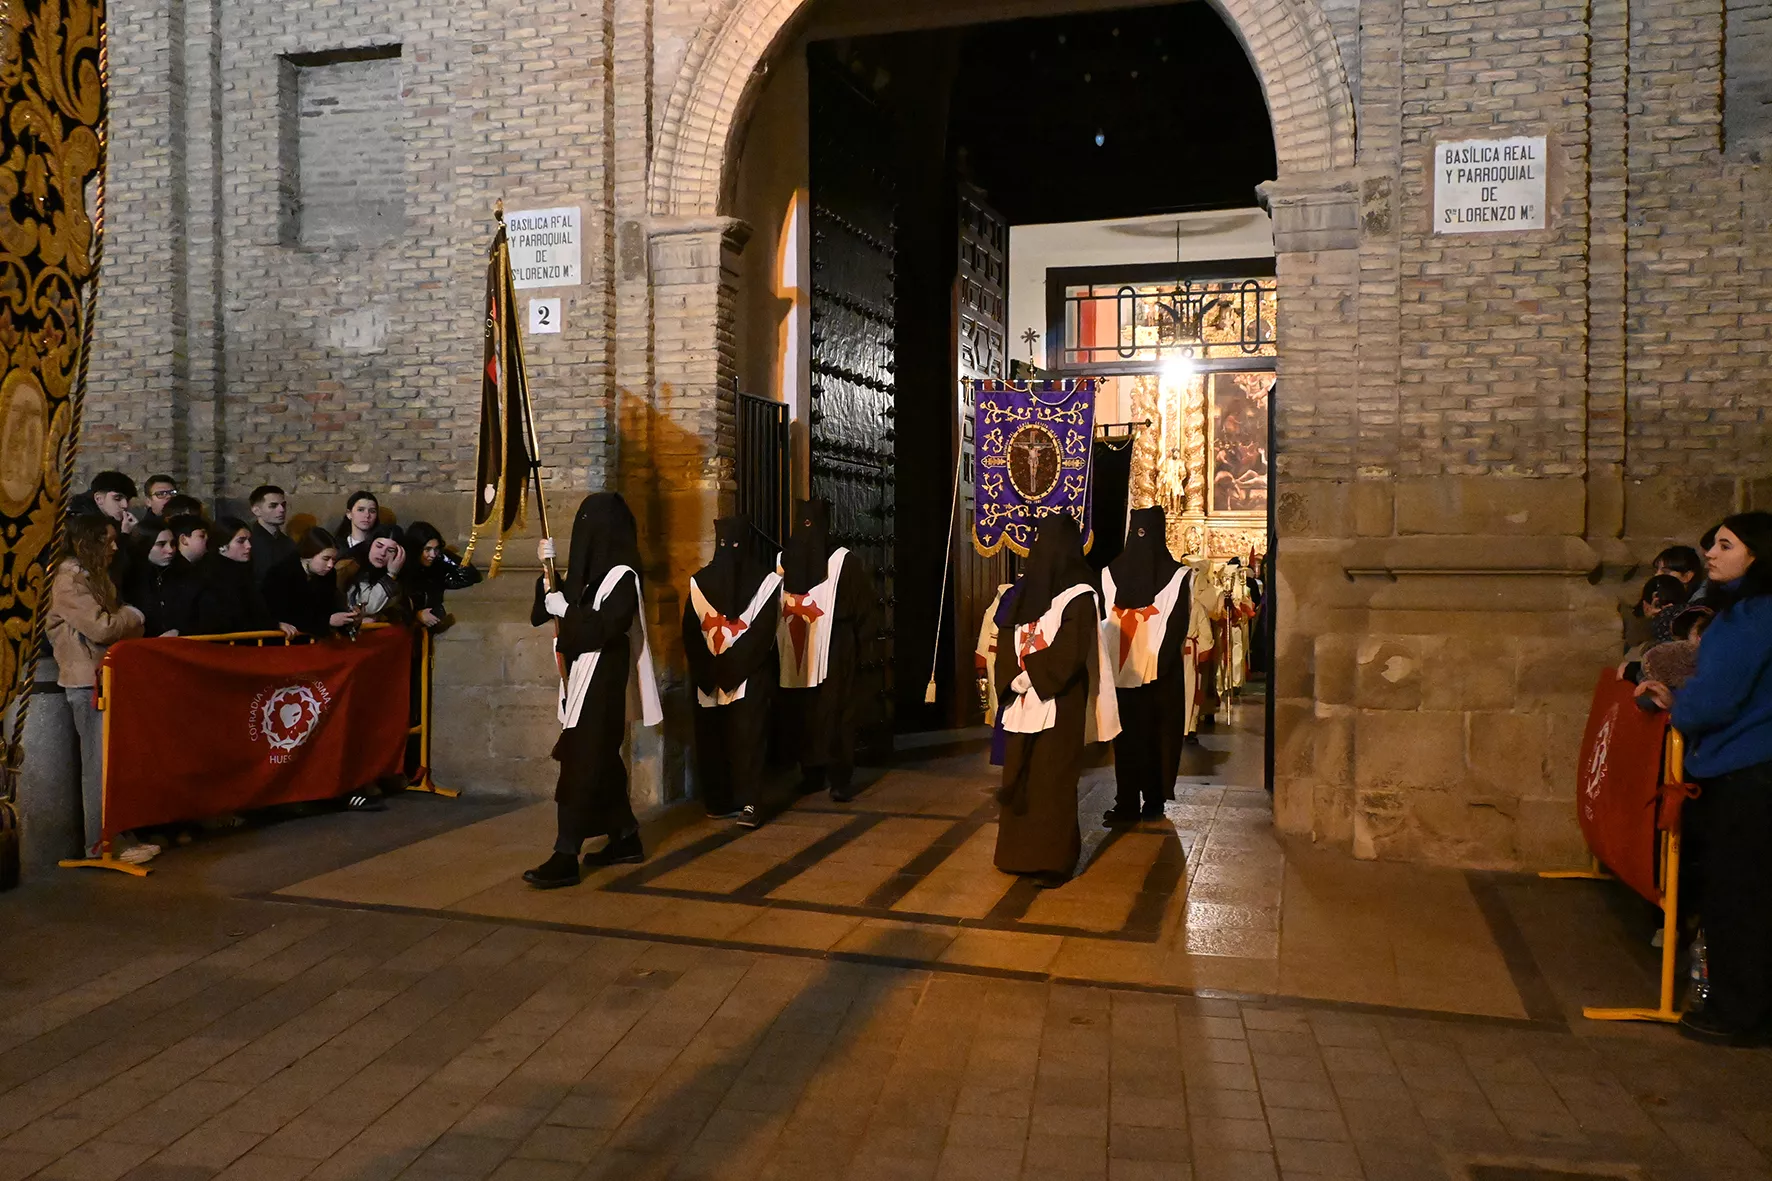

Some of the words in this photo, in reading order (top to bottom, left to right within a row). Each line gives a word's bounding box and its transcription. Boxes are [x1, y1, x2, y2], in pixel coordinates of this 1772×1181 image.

[1504, 145, 1535, 161] REAL
[1446, 169, 1453, 184] Y
[1457, 165, 1535, 183] PARROQUIAL
[1481, 186, 1498, 202] DE
[1458, 205, 1516, 223] LORENZO
[510, 236, 516, 248] Y
[519, 231, 573, 247] PARROQUIAL
[535, 250, 547, 263] DE
[520, 265, 560, 280] LORENZO
[538, 306, 550, 326] 2
